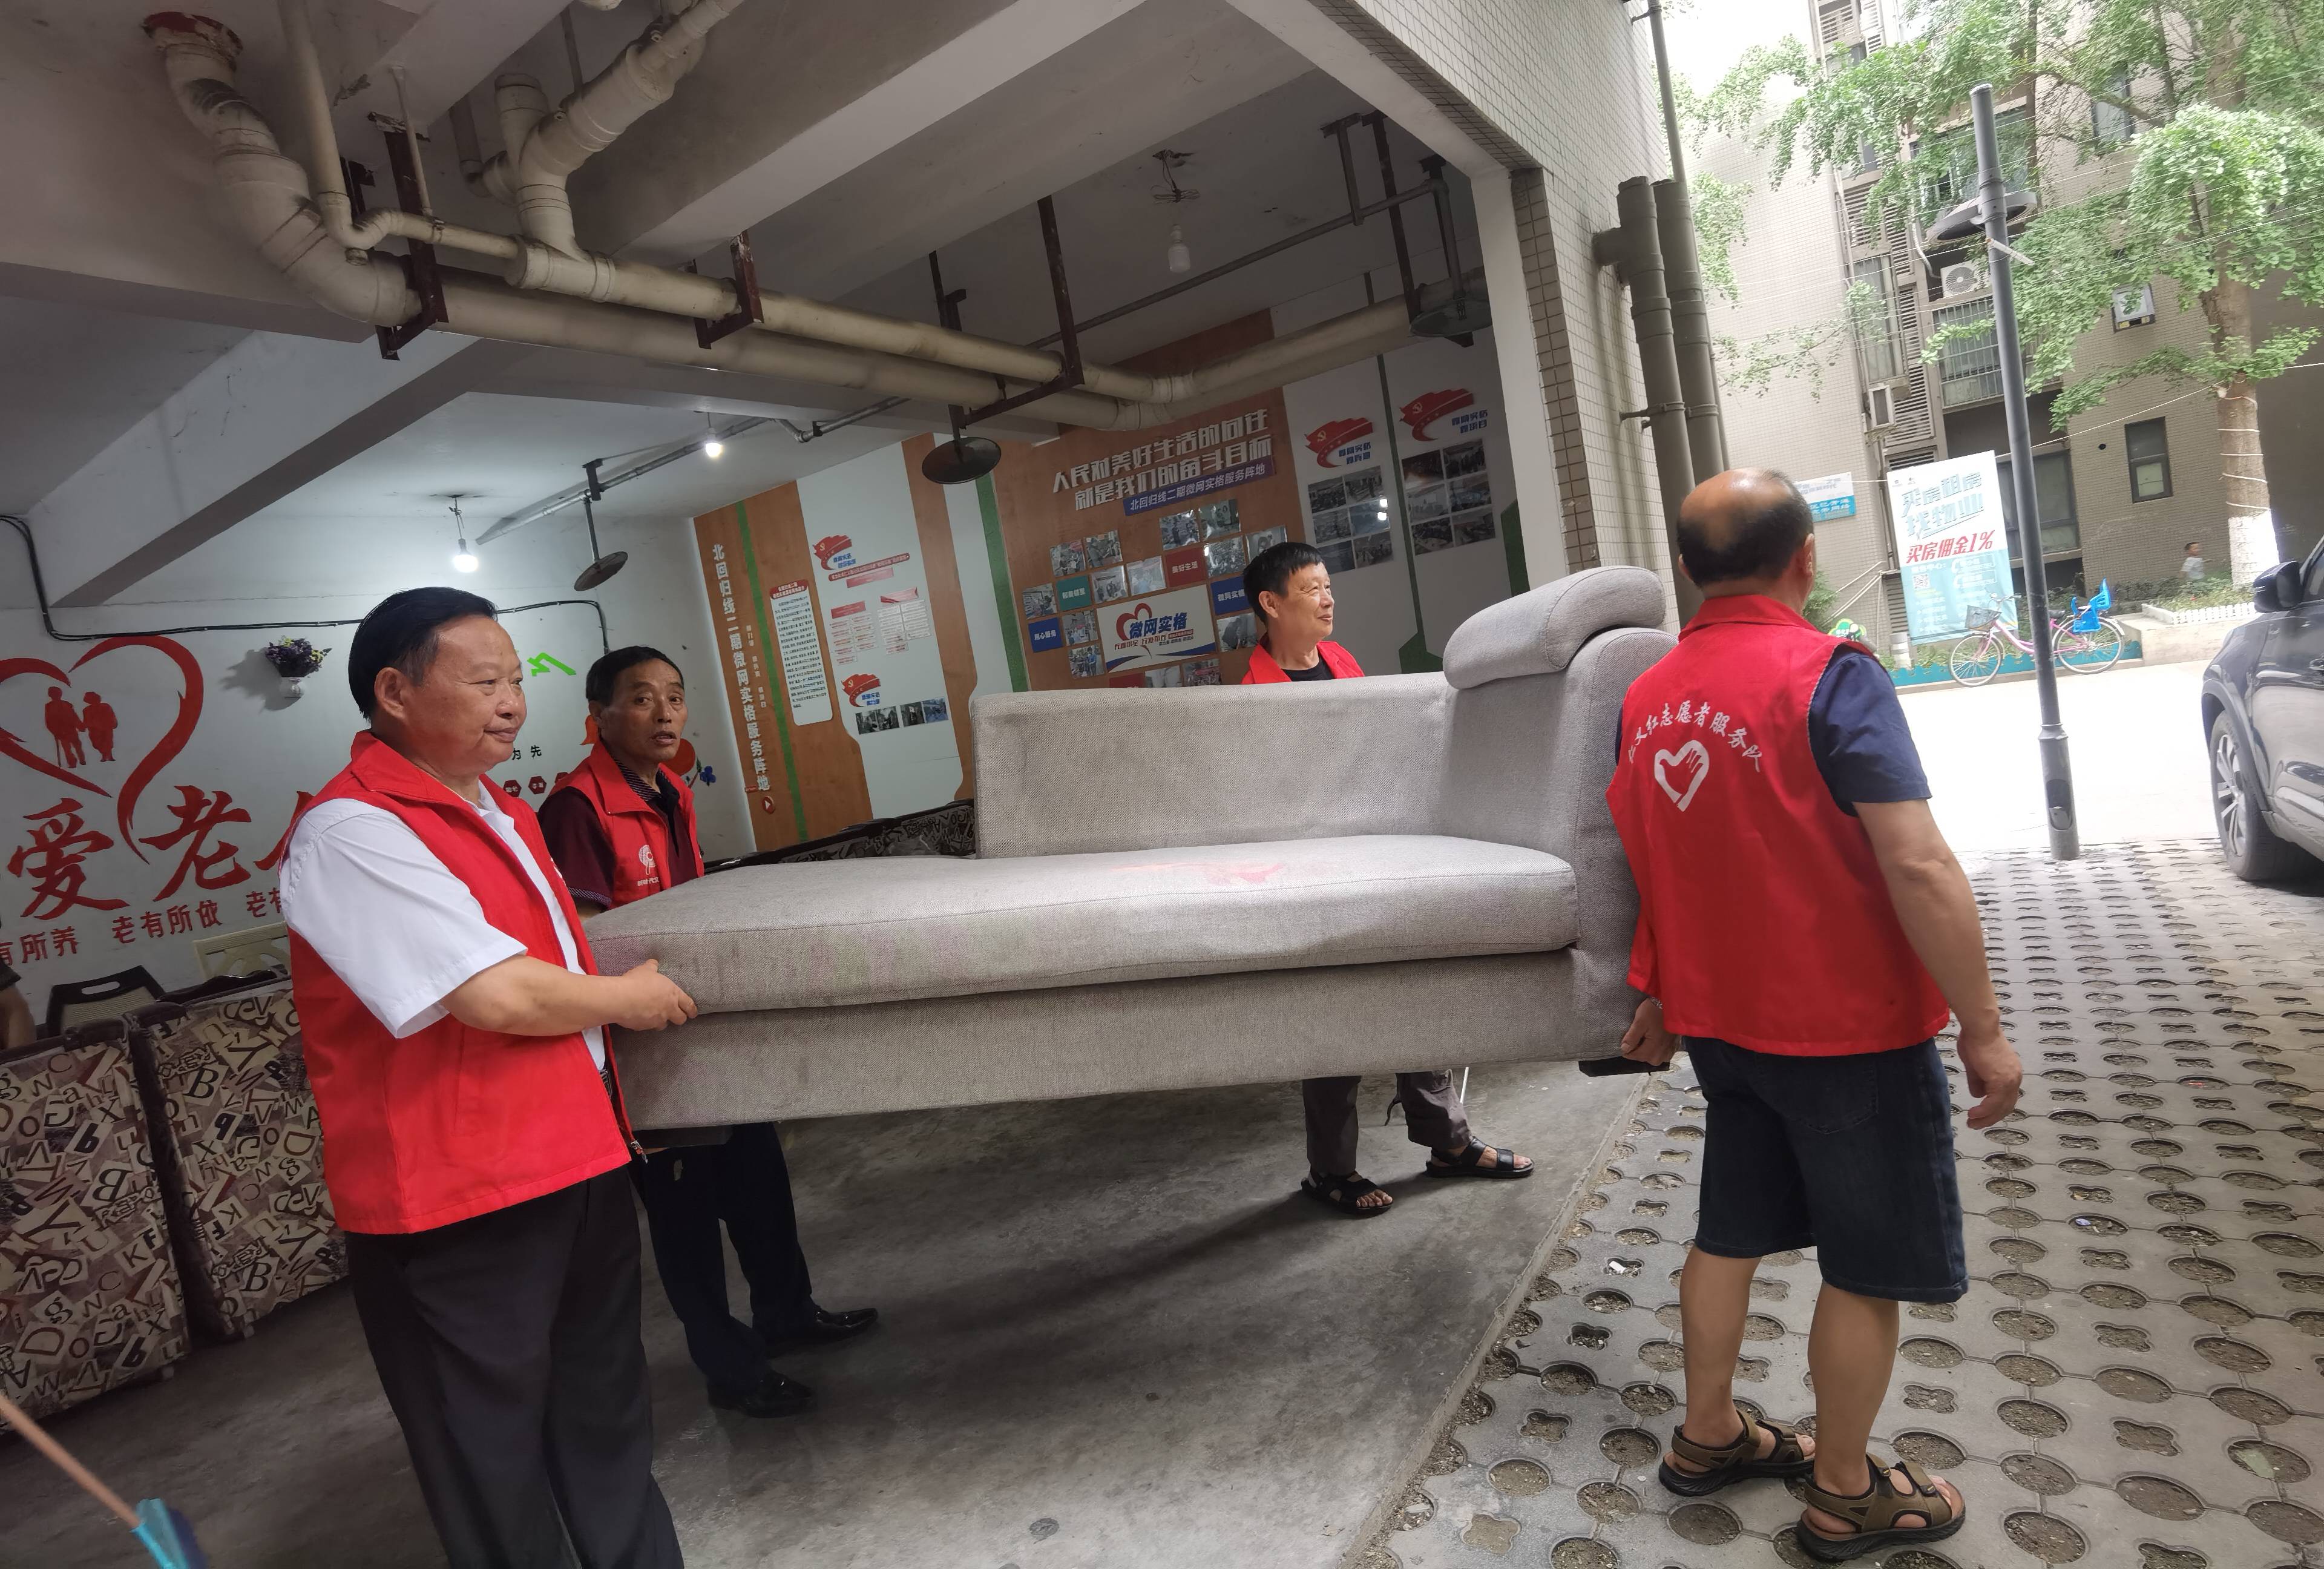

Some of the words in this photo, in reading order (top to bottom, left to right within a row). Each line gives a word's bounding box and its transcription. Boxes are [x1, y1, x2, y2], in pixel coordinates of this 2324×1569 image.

[1052, 409, 1268, 493] 人民对美好生活的向往
[1075, 435, 1272, 510] 就是我们的奋斗目标
[1130, 463, 1265, 511] 北回归线二期微网实格服务阵地
[1906, 530, 1995, 564] 买房佣金1%
[1129, 612, 1187, 640] 微网实格
[111, 900, 223, 944] 老有所依
